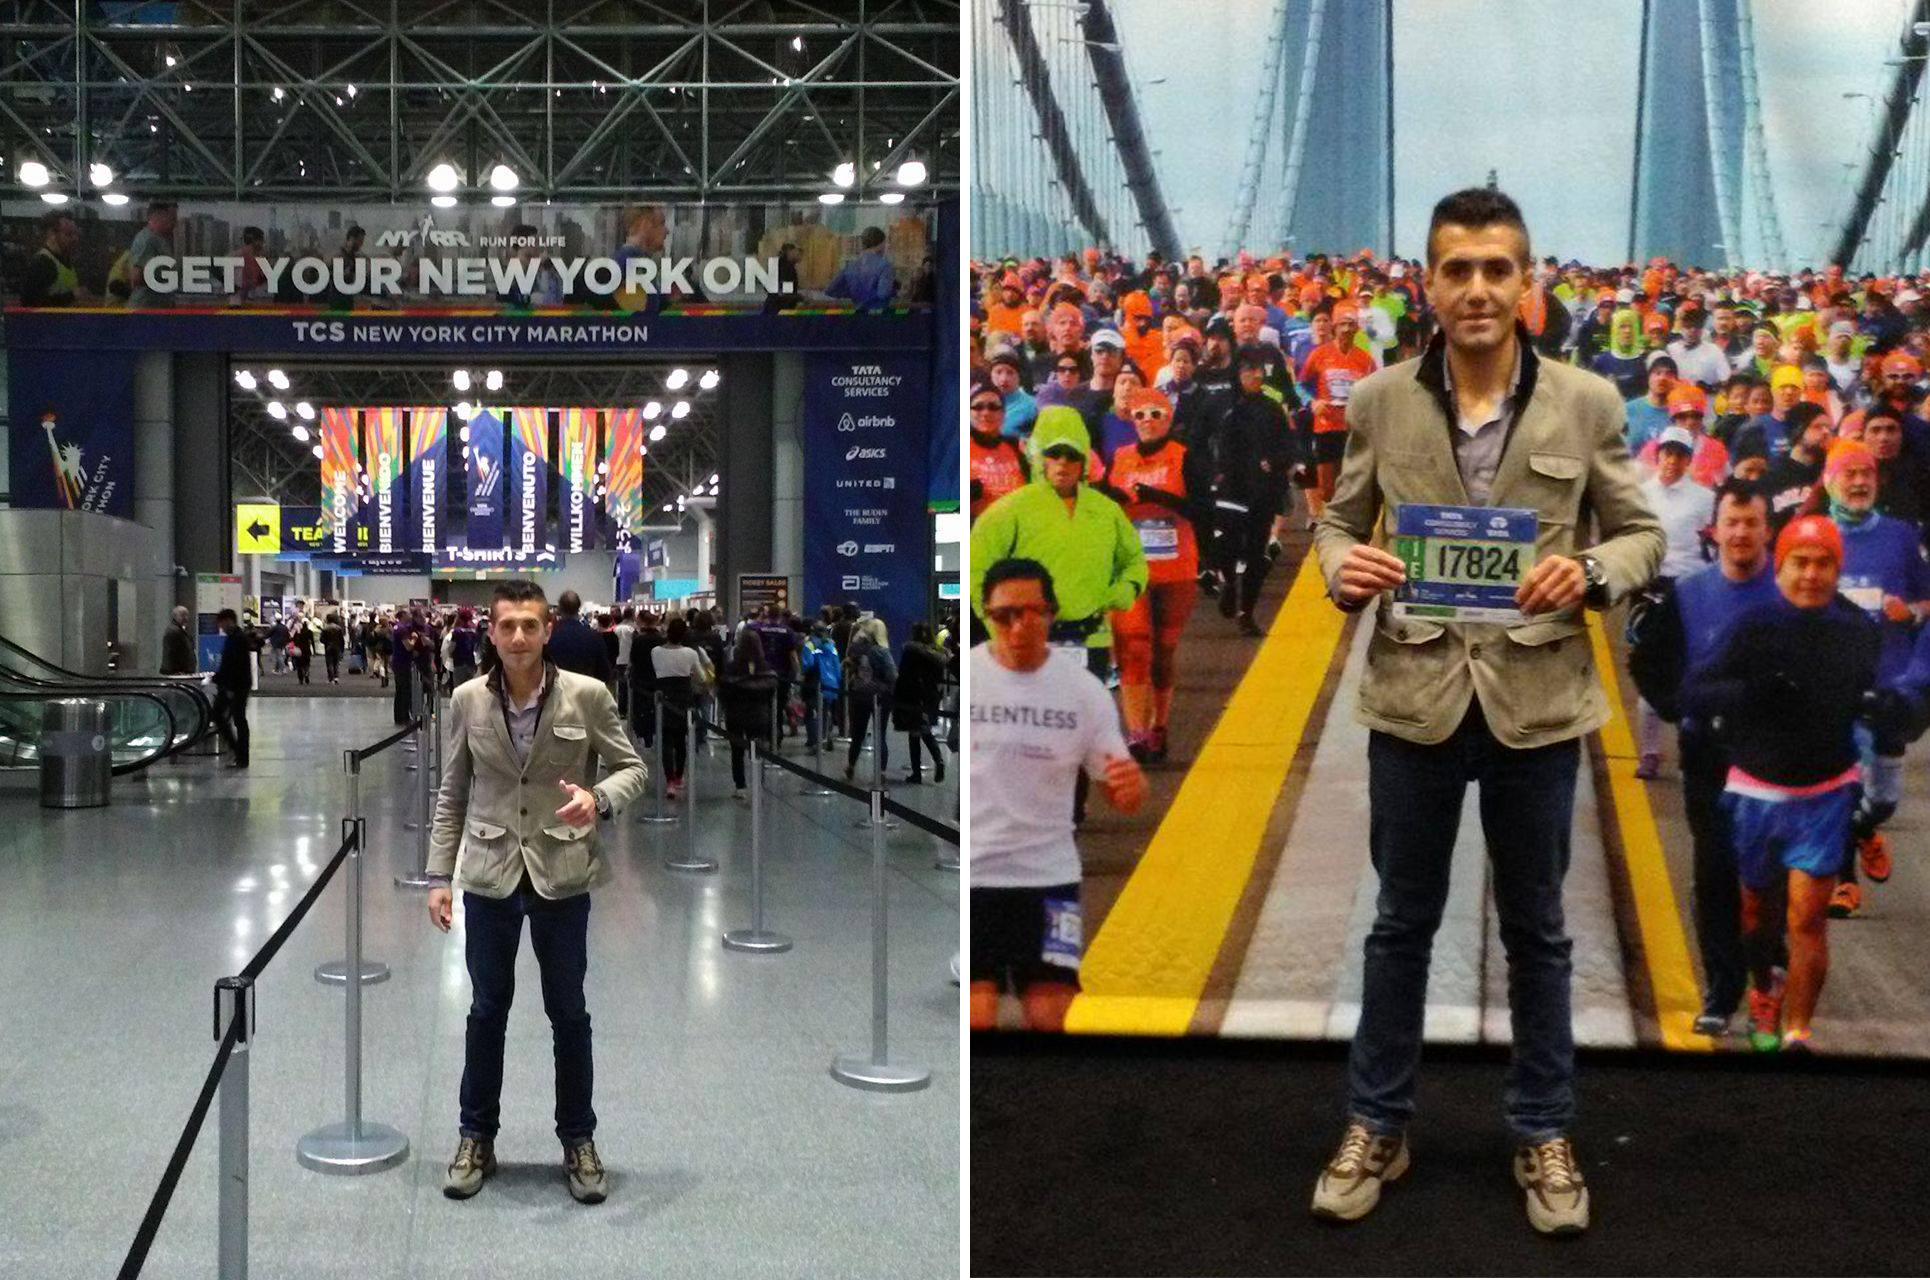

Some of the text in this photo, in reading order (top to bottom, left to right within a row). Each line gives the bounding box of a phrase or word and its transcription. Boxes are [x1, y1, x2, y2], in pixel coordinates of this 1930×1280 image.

[479, 236, 566, 248] RUN FOR LIFE
[143, 256, 794, 295] GET YOUR NEW YORK ON.
[293, 321, 649, 343] TCS NEW YORK CITY MARATHON
[851, 365, 881, 375] TATA
[831, 376, 902, 387] CONSULTANCY
[844, 387, 889, 397] SERVICES
[857, 415, 896, 427] airbnb
[81, 455, 111, 512] ORK CITY
[836, 479, 882, 488] UNITED
[333, 470, 347, 554] WELCOME
[422, 459, 435, 554] BIENVENUE
[522, 451, 536, 554] BENVENUTO
[1438, 544, 1521, 581] 17824
[970, 705, 1077, 728] ELENTLESS
